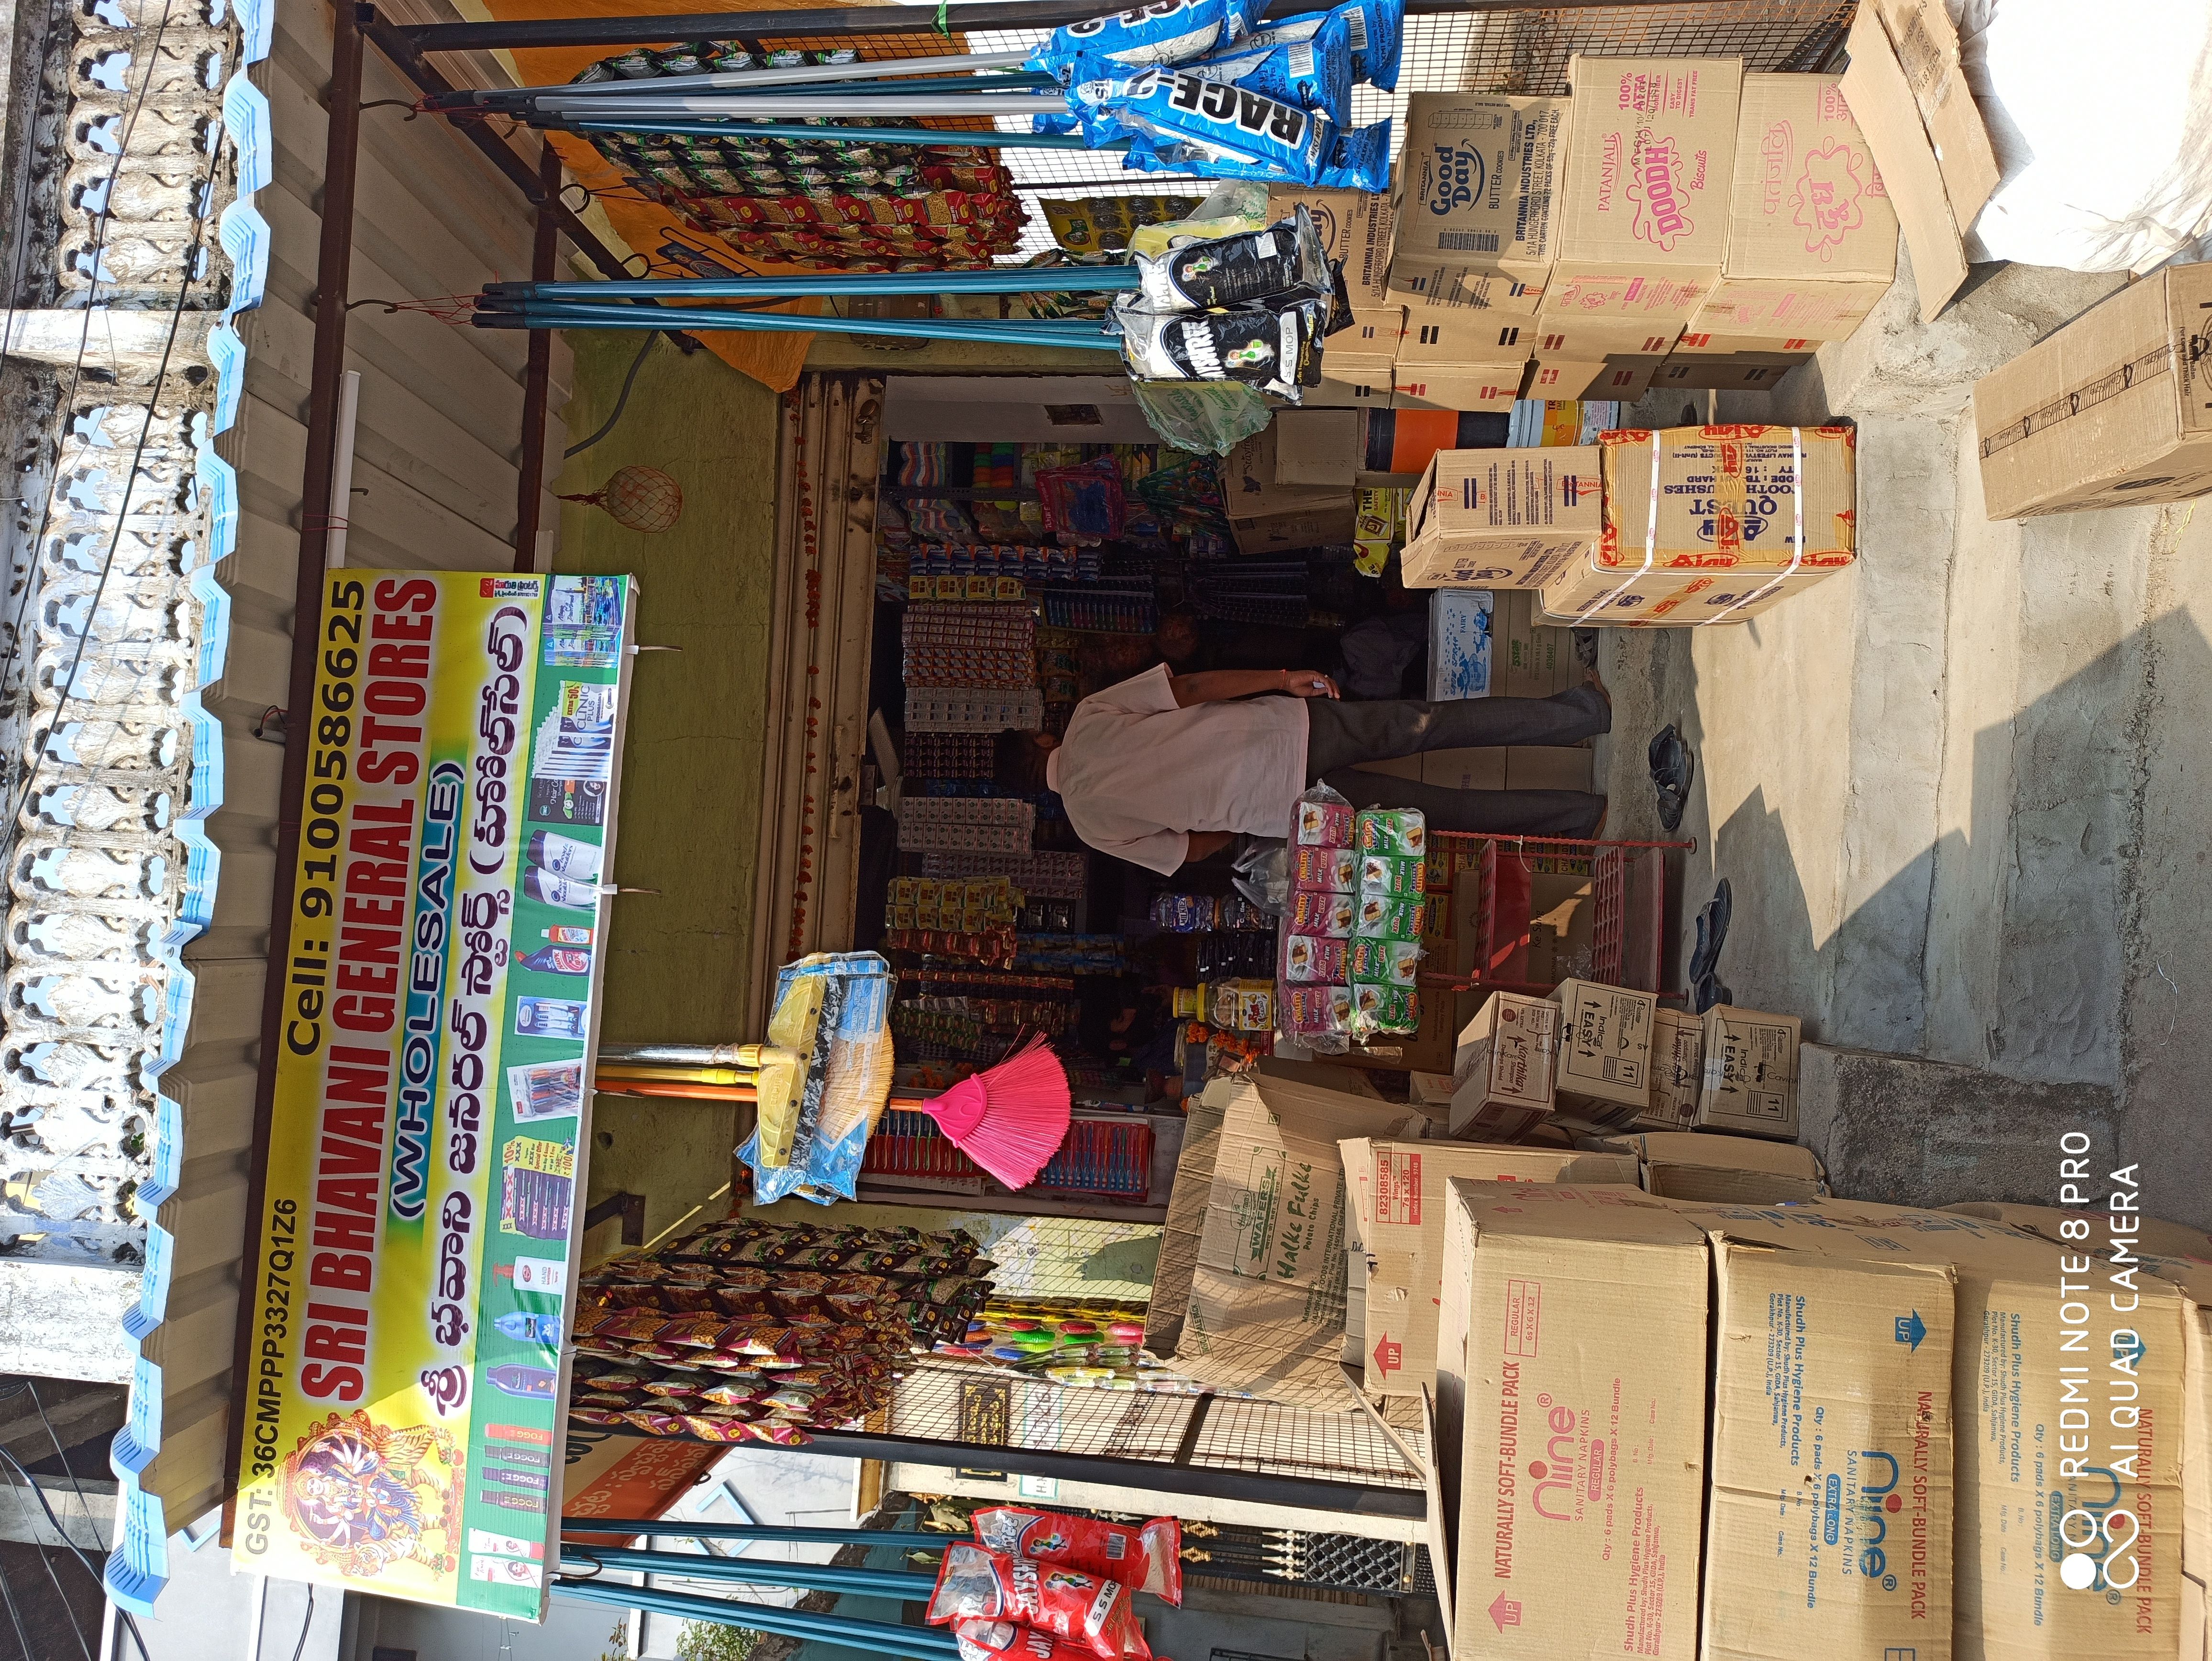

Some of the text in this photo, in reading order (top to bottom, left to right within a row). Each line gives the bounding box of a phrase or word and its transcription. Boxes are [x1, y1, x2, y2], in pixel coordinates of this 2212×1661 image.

[1374, 3, 1386, 44] PRODUCTS
[1384, 18, 1393, 39] INDIA
[1371, 29, 1380, 71] Manufactures
[1123, 68, 1304, 145] RACE-2
[1618, 72, 1633, 111] 100%
[1633, 74, 1647, 111] ATTA
[1823, 83, 1837, 122] 100%
[1537, 123, 1548, 136] 700
[1519, 141, 1534, 193] INDUSTRIES
[1534, 142, 1547, 169] KOLKATA
[1597, 138, 1617, 212] PATANJALI
[1690, 150, 1708, 190] Biscuits
[1759, 126, 1785, 216] पतंजलि
[1419, 160, 1429, 201] BRITANNIA
[1429, 144, 1454, 216] Good
[1451, 150, 1477, 208] Day
[1488, 150, 1504, 210] BUTTER COOKIES
[1532, 169, 1544, 196] STREET,
[1644, 144, 1684, 236] DOODH
[1516, 195, 1529, 242] BRITANNIA
[1528, 196, 1542, 240] HUNGERFORD
[1807, 177, 1849, 231] दूध
[1526, 241, 1538, 255] 5/1A
[1284, 327, 1294, 354] MOP
[1362, 490, 1372, 511] THE
[1690, 498, 1778, 516] QUEST
[1460, 614, 1468, 633] FAIRY
[1546, 642, 1555, 671] 4036407
[575, 685, 591, 731] CLINIC
[586, 700, 595, 721] PLUS
[550, 788, 559, 805] Hair
[286, 580, 365, 1056] Cell: 9100586625
[561, 845, 573, 872] shoulders
[1299, 851, 1308, 879] KWALITY
[1319, 851, 1327, 869] RUSK
[1394, 860, 1405, 892] MILK RUSK
[1416, 863, 1425, 892] KWALITY
[1178, 898, 1189, 925] MILKIEZ
[1532, 910, 1545, 949] Ke Sung
[554, 952, 565, 970] HARPIC
[300, 577, 437, 1401] SRI BHAVANI GENERAL STORES
[391, 761, 465, 1220] (WHOLESALE)
[1293, 994, 1303, 1021] KWALITY
[1312, 991, 1322, 1024] MILK RUSK
[1508, 1061, 1516, 1084] Shampoo
[1514, 1044, 1529, 1088] Karthika
[1723, 1045, 1736, 1083] EASY
[448, 997, 487, 1174] జనరల్
[504, 1140, 515, 1163] 10%
[1330, 1183, 1342, 1209] PRIVATE
[1379, 1159, 1389, 1215] 82308585
[1402, 1196, 1410, 1208] 7s
[1234, 1191, 1251, 1227] Haldiram's
[1250, 1177, 1271, 1247] WAFERS
[1276, 1162, 1312, 1279] Halke Fulke
[1303, 1197, 1319, 1251] Potato Chips
[1320, 1210, 1337, 1264] INTERNATIONAL
[431, 1190, 471, 1347] భవాని
[1316, 1265, 1328, 1292] FOODS
[1301, 1290, 1314, 1323] Marketed
[1311, 1293, 1325, 1325] HALDIRAM
[1510, 1297, 1521, 1337] REGULAR
[1191, 1303, 1210, 1354] WHOLESALE PACK
[1898, 1318, 1911, 1342] UP
[1388, 1347, 1399, 1364] UP
[244, 1198, 298, 1555] GST: 36CMPPP3327Q1Z6
[420, 1365, 467, 1417] శ్రీ
[1791, 1295, 1805, 1466] Shudh Plus Hygiene Products
[1493, 1361, 1521, 1579] NATURALLY SOFT-BUNDLE PACK
[1574, 1409, 1591, 1522] SANITARY NAPKINS
[1590, 1449, 1603, 1492] REGULAR
[1825, 1478, 1838, 1542] EXTRA LONG
[1841, 1449, 1857, 1575] SANITARY NAPKINS
[1910, 1391, 1932, 1619] NAURALLY SOFT-BUNDLE PACK
[1623, 1486, 1645, 1651] Shudh Plus Hygiene Products
[1505, 1602, 1519, 1623] UP
